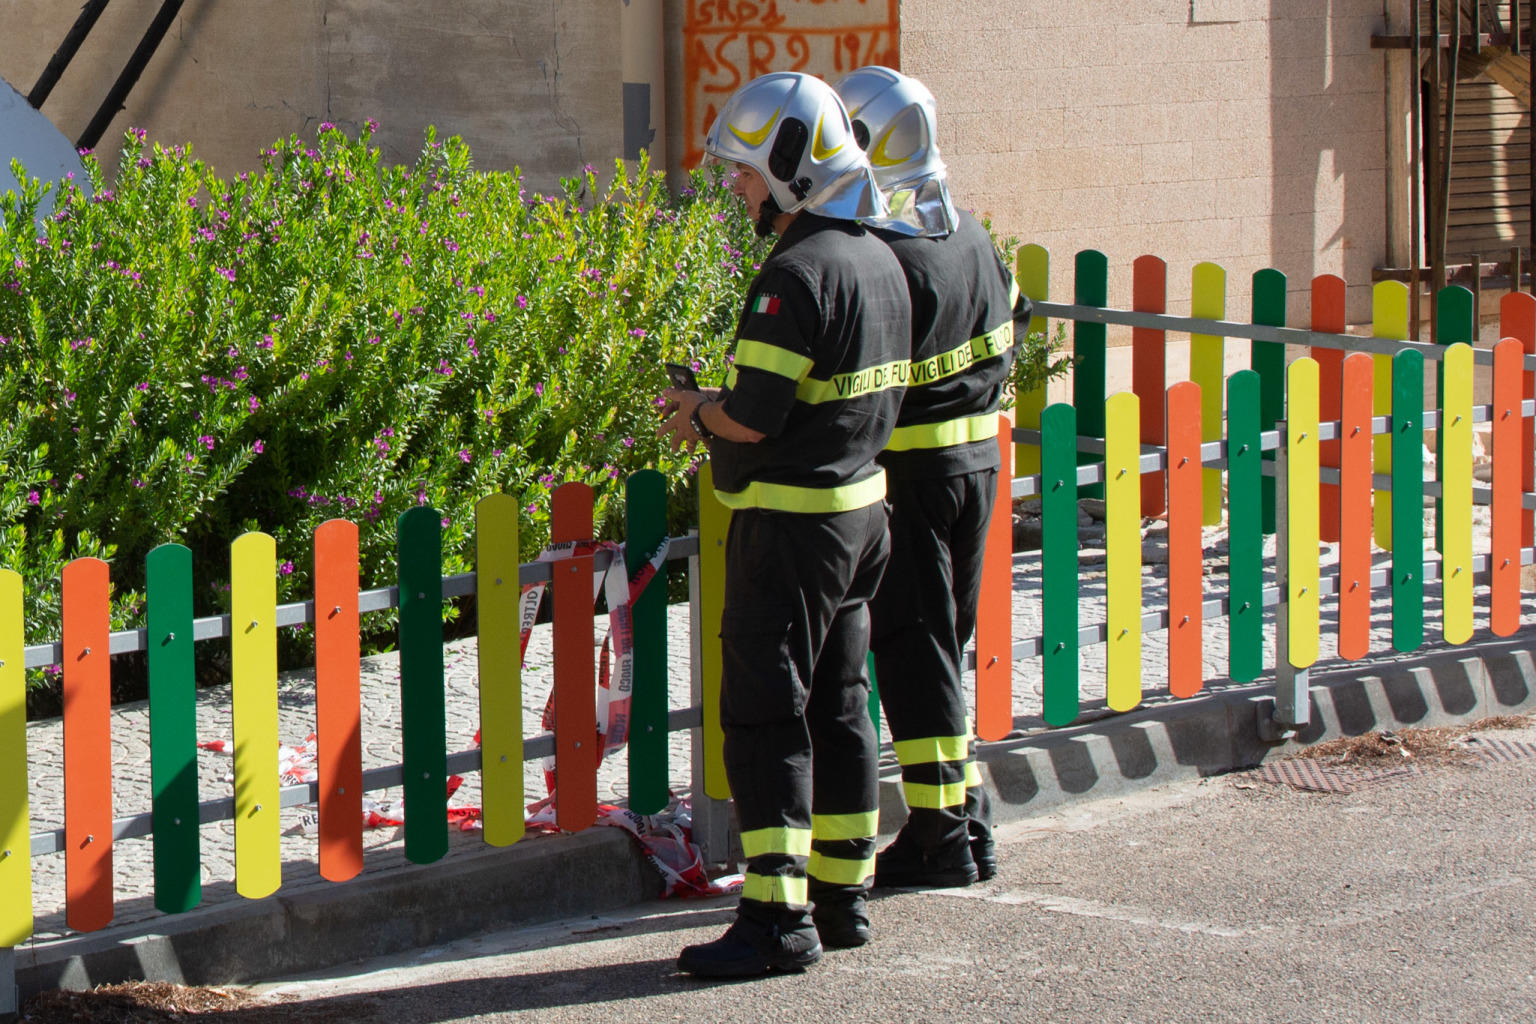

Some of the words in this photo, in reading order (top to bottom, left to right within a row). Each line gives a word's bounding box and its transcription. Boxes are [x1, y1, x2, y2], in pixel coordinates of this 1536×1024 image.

[910, 353, 954, 383] VIGILI
[957, 342, 982, 369] DEL
[833, 370, 871, 396] VIGILI
